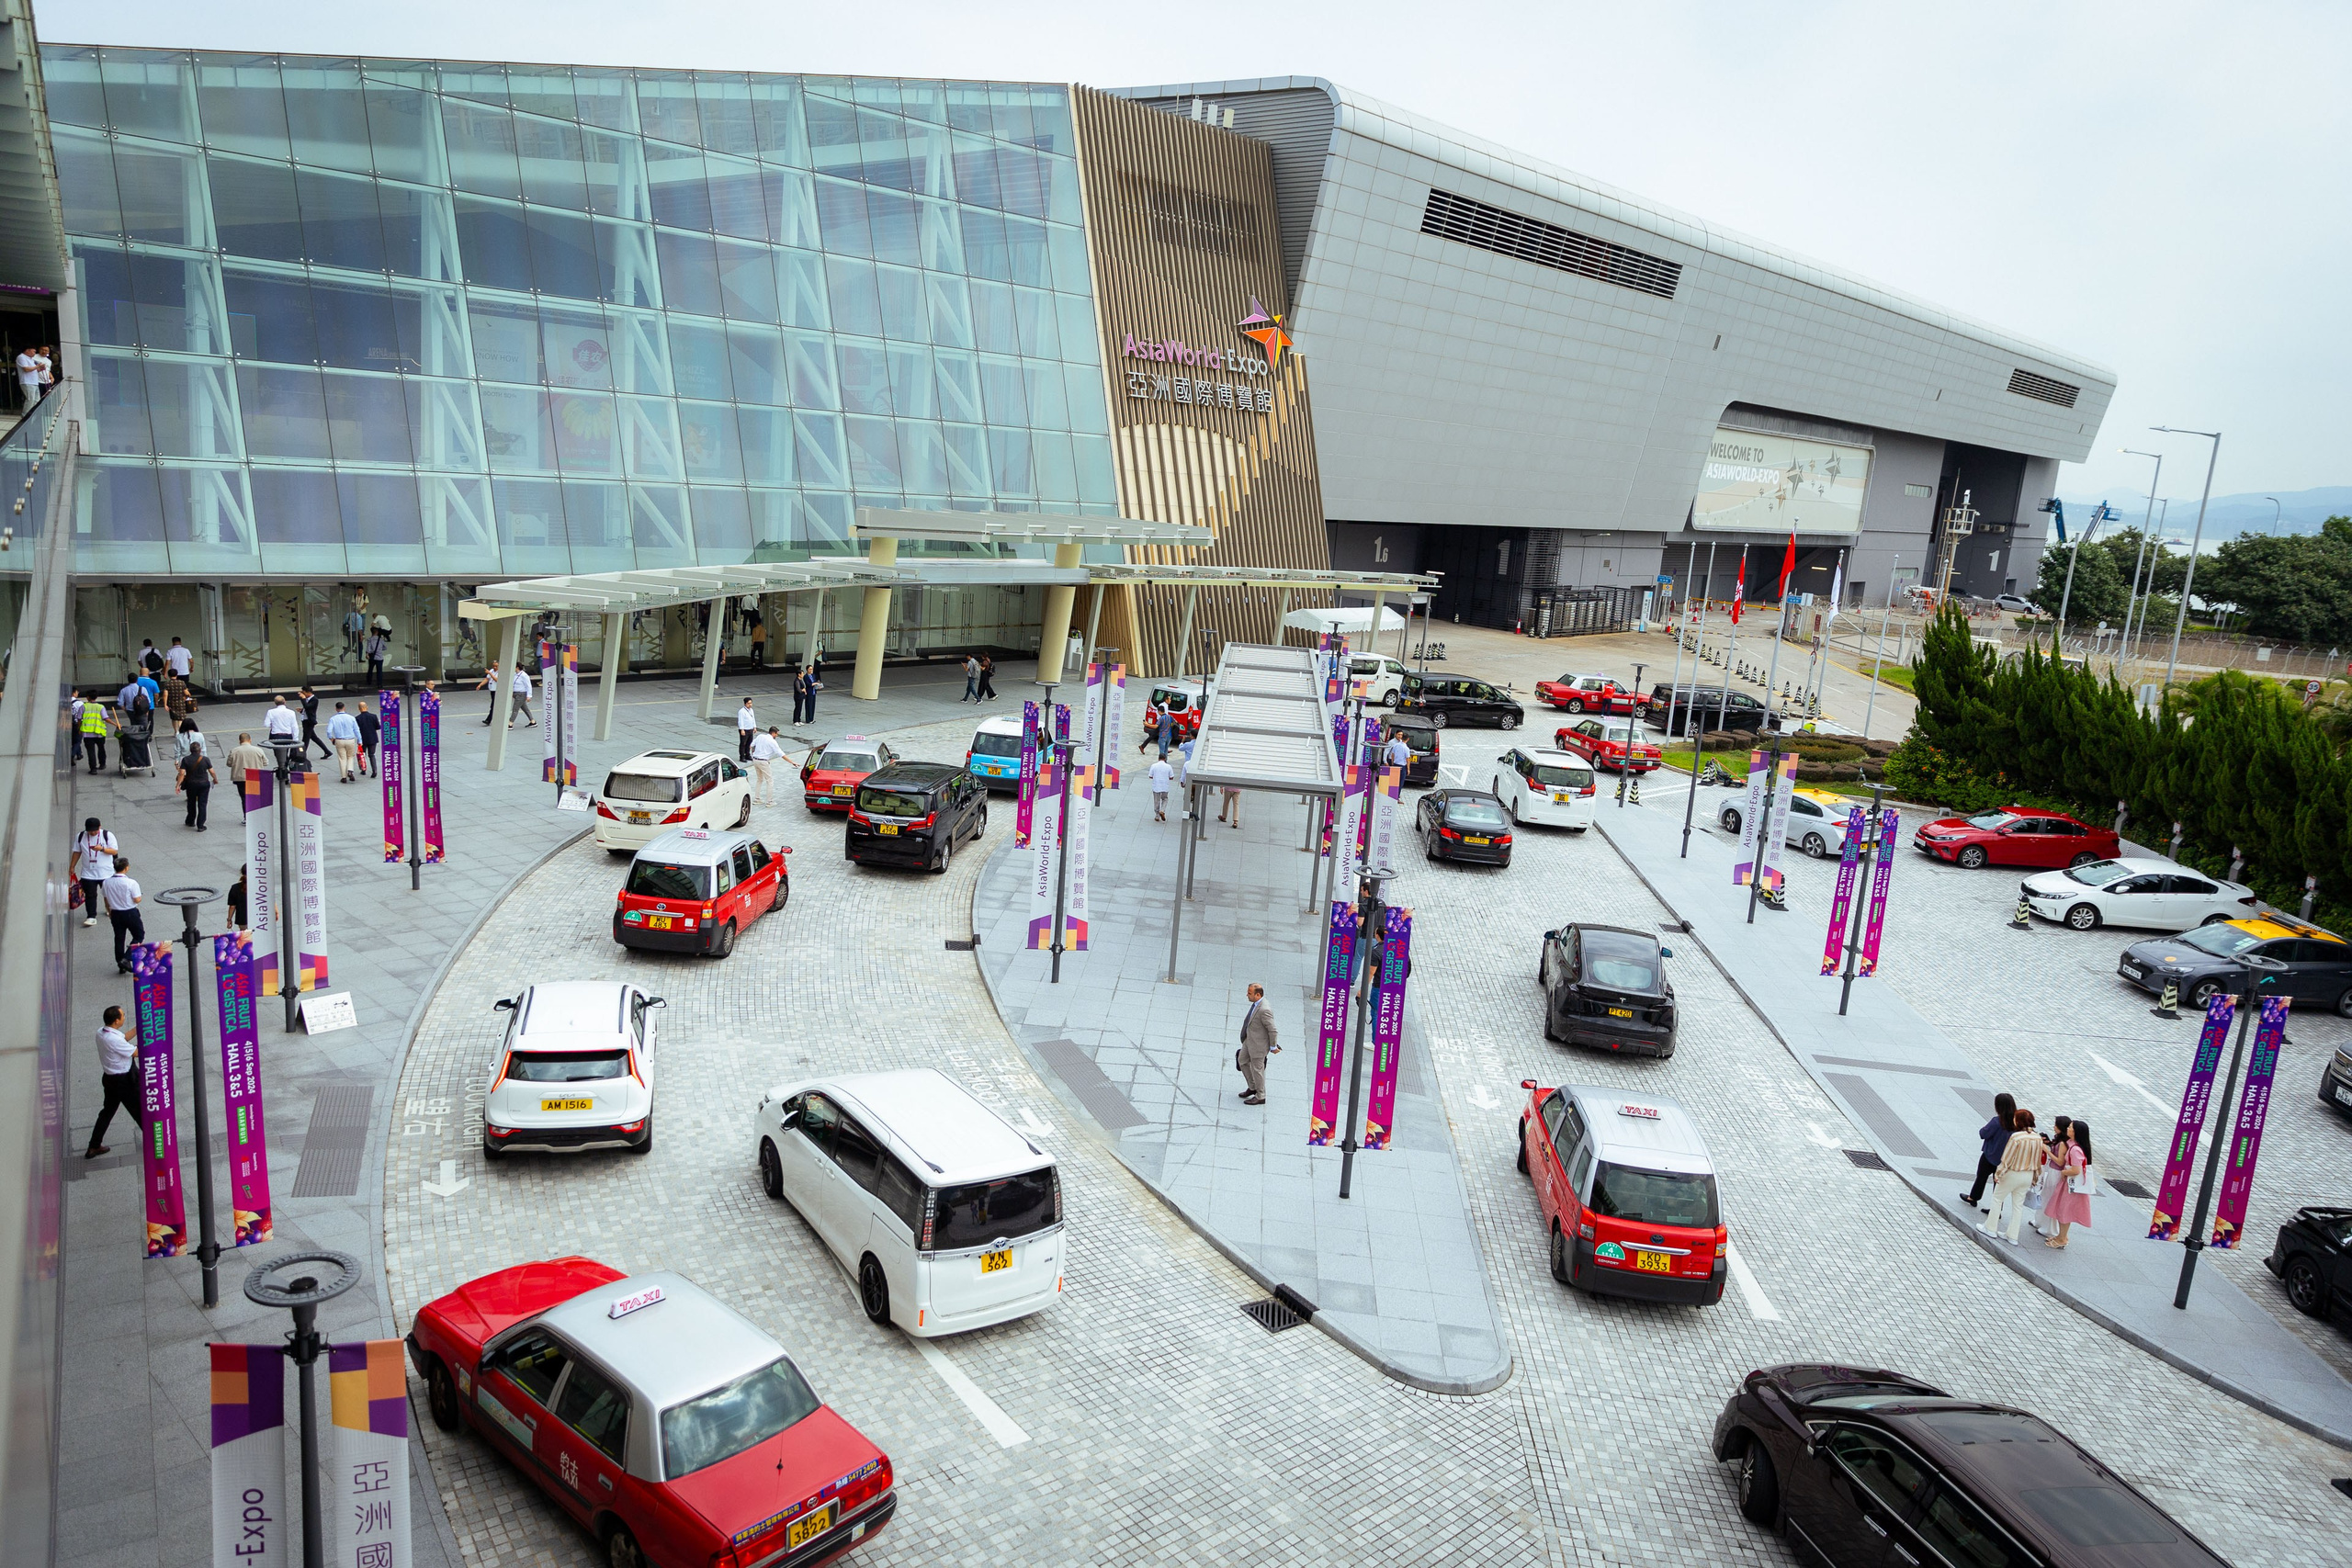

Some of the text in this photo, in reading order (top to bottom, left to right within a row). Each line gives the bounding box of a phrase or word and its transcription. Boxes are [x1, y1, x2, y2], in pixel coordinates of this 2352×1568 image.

[1125, 333, 1268, 380] AsiaWorld-Expo
[1127, 371, 1272, 412] 亞洲國際博覽館
[1710, 442, 1764, 464] WELCOME TO
[1705, 463, 1781, 485] ASIAWORLD-EXPO
[1374, 536, 1389, 563] 1.6
[1988, 550, 2000, 572] 1
[2308, 682, 2319, 691] 35
[545, 681, 553, 744] AsiaWorld-Expo
[1085, 697, 1095, 752] AsiaWorld-Expo
[1743, 785, 1760, 849] AsiaWorld-Expo
[1037, 816, 1054, 897] AsiaWorld-Expo
[1341, 811, 1356, 886] AsiaWorld-Expo
[1843, 829, 1855, 862] LOGISTICA
[1849, 829, 1861, 863] ASIA FRUIT
[1879, 829, 1889, 863] LOGISTICA
[1884, 844, 1893, 863] FRUIT
[254, 831, 269, 931] AsiaWorld-Expo
[300, 824, 322, 944] 亞洲國際博覽館
[1838, 866, 1849, 885] HALL
[1875, 868, 1883, 886] HALL
[1329, 932, 1341, 980] LOGISTICA
[1338, 933, 1351, 981] ASIA FRUIT
[1384, 938, 1396, 985] LOGISTICA
[1393, 938, 1407, 986] ASIA FRUIT
[140, 985, 154, 1047] LOGISTICA
[153, 983, 167, 1042] ASIA FRUIT
[221, 973, 238, 1034] LOGISTICA
[235, 972, 251, 1030] ASIA FRUIT
[1324, 987, 1337, 1031] HALL 3&5
[1336, 1005, 1345, 1017] Sep
[1379, 992, 1391, 1035] HALL 3&5
[1391, 1010, 1399, 1021] Sep
[1390, 1021, 1398, 1036] 2024
[2195, 1026, 2215, 1074] LOGISTICA
[2205, 1026, 2225, 1073] ASIA FRUIT
[2251, 1028, 2269, 1077] LOGISTICA
[2262, 1029, 2279, 1077] ASIA FRUIT
[144, 1055, 160, 1112] HALL 3&5
[161, 1075, 169, 1089] Sep
[227, 1043, 243, 1099] HALL 3&5
[244, 1062, 254, 1077] Sep
[163, 1089, 171, 1109] 2024
[246, 1076, 256, 1095] 2024
[464, 1076, 489, 1112] LOOK
[2245, 1084, 2258, 1108] HALL
[547, 1100, 587, 1110] AM 1516
[1624, 1105, 1657, 1117] TAXI
[2182, 1080, 2200, 1124] HALL 3&5
[2193, 1110, 2202, 1124] 2024
[2197, 1099, 2206, 1111] Sep
[2256, 1103, 2265, 1115] Sep
[239, 1108, 247, 1144] ASIAFRUIT
[2240, 1108, 2253, 1129] 3&5
[2253, 1114, 2262, 1130] 2024
[154, 1122, 163, 1158] ASIAFRUIT
[988, 1258, 1008, 1272] 562
[989, 1251, 1005, 1262] WN
[1639, 1260, 1668, 1271] 3933
[1646, 1252, 1661, 1262] KD
[619, 1289, 661, 1312] TAXI
[560, 1451, 579, 1476] 的士
[560, 1465, 579, 1490] TAXI
[848, 1470, 864, 1483] 5477
[353, 1461, 392, 1568] 亞洲國
[801, 1513, 817, 1529] WP
[794, 1517, 826, 1545] 3822
